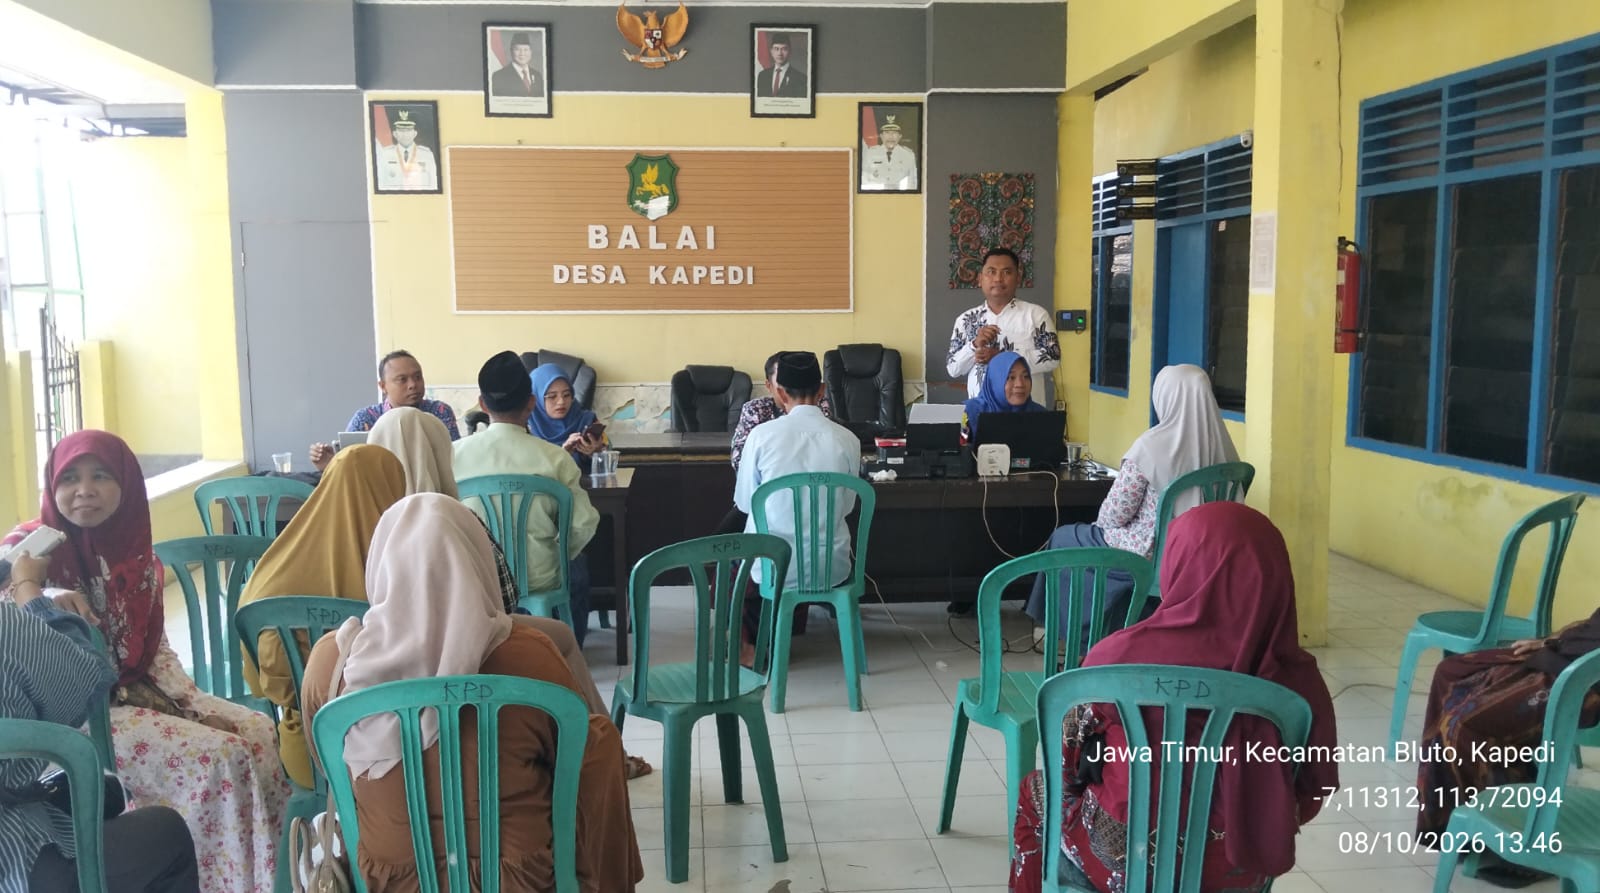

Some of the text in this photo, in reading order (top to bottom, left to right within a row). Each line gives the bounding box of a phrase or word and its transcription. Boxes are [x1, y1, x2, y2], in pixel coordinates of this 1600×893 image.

[588, 224, 715, 250] BALAI
[553, 264, 754, 285] DESA KAPEDI
[306, 607, 342, 625] KPD
[443, 681, 494, 702] KPD
[1155, 677, 1210, 698] KPD
